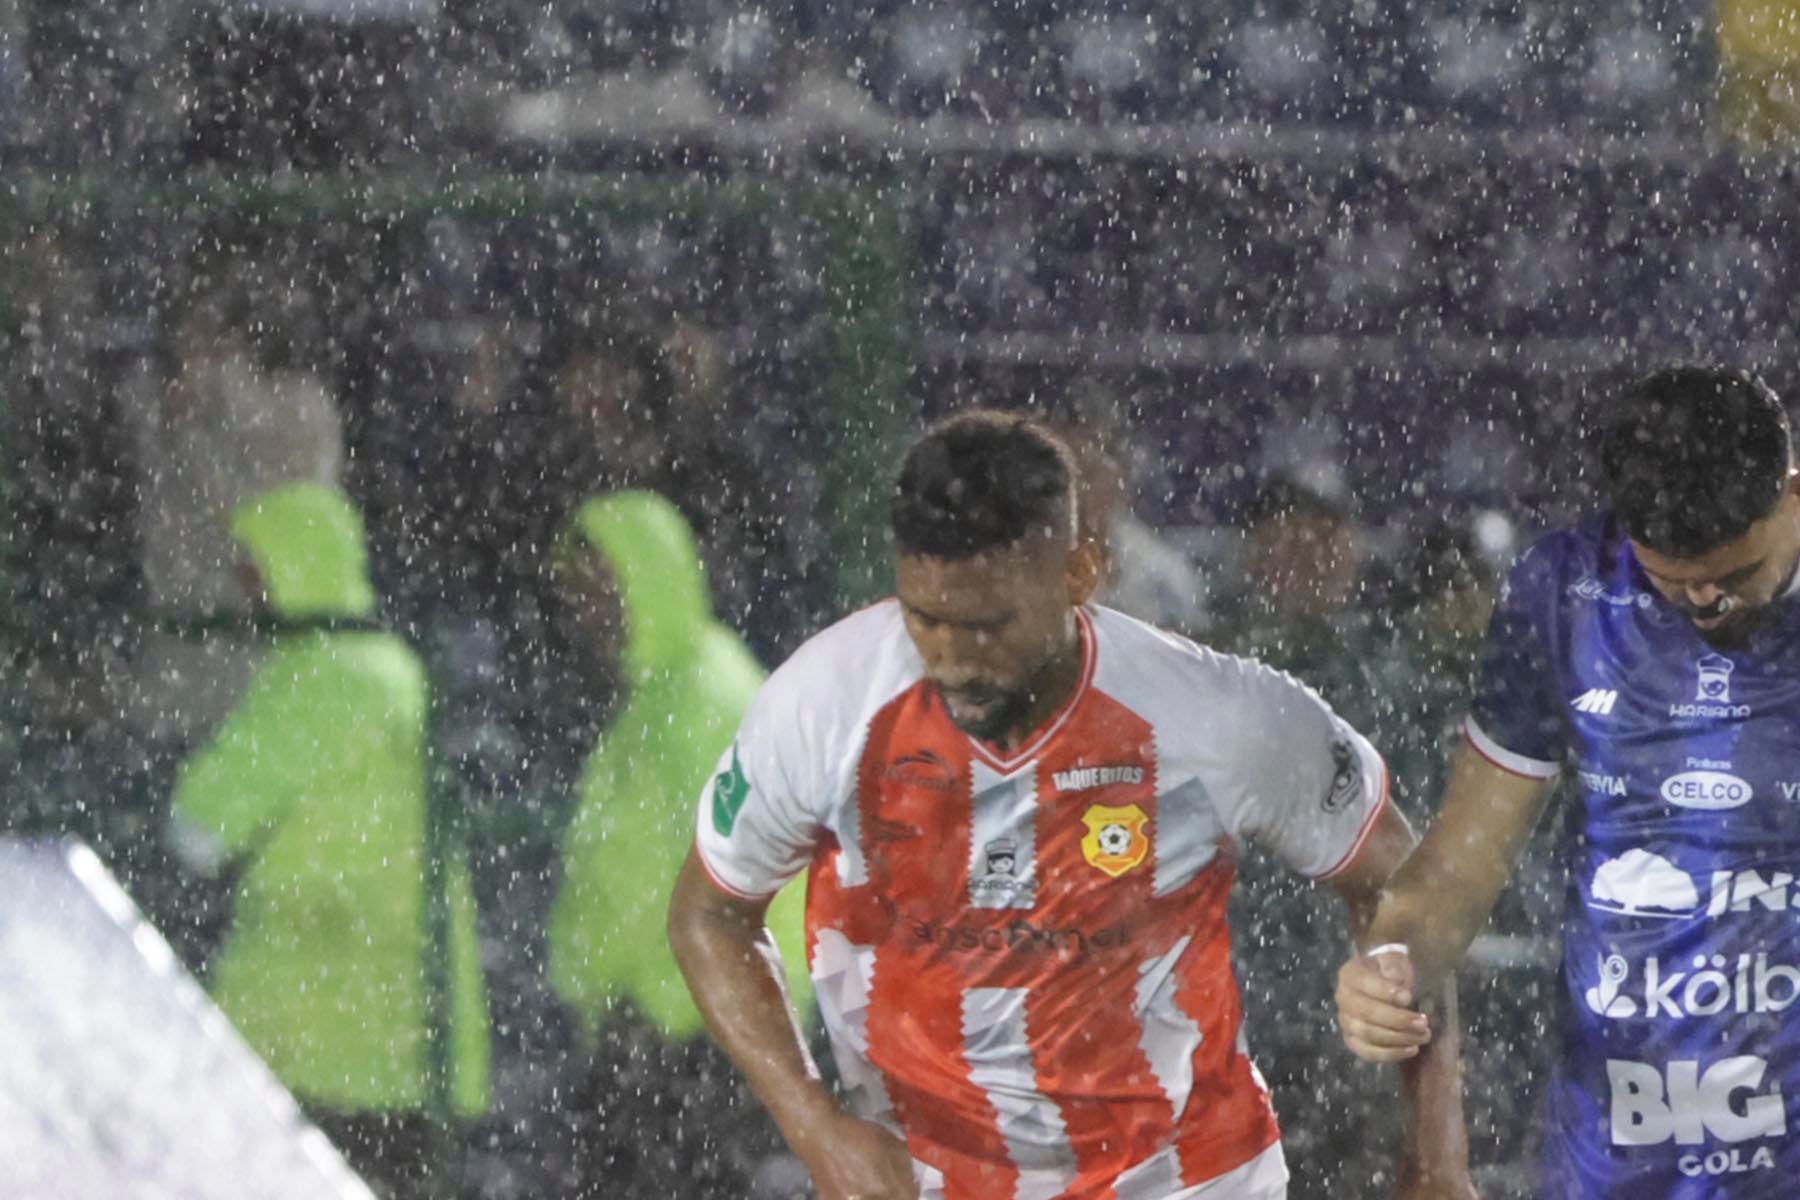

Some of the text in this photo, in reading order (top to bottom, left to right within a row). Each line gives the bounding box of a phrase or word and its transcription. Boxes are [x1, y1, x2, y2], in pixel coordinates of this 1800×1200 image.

[1052, 765, 1144, 791] TAQUERITOS
[1668, 781, 1743, 801] CELCO
[1606, 1055, 1787, 1145] BIG
[1678, 1146, 1775, 1177] COLA
